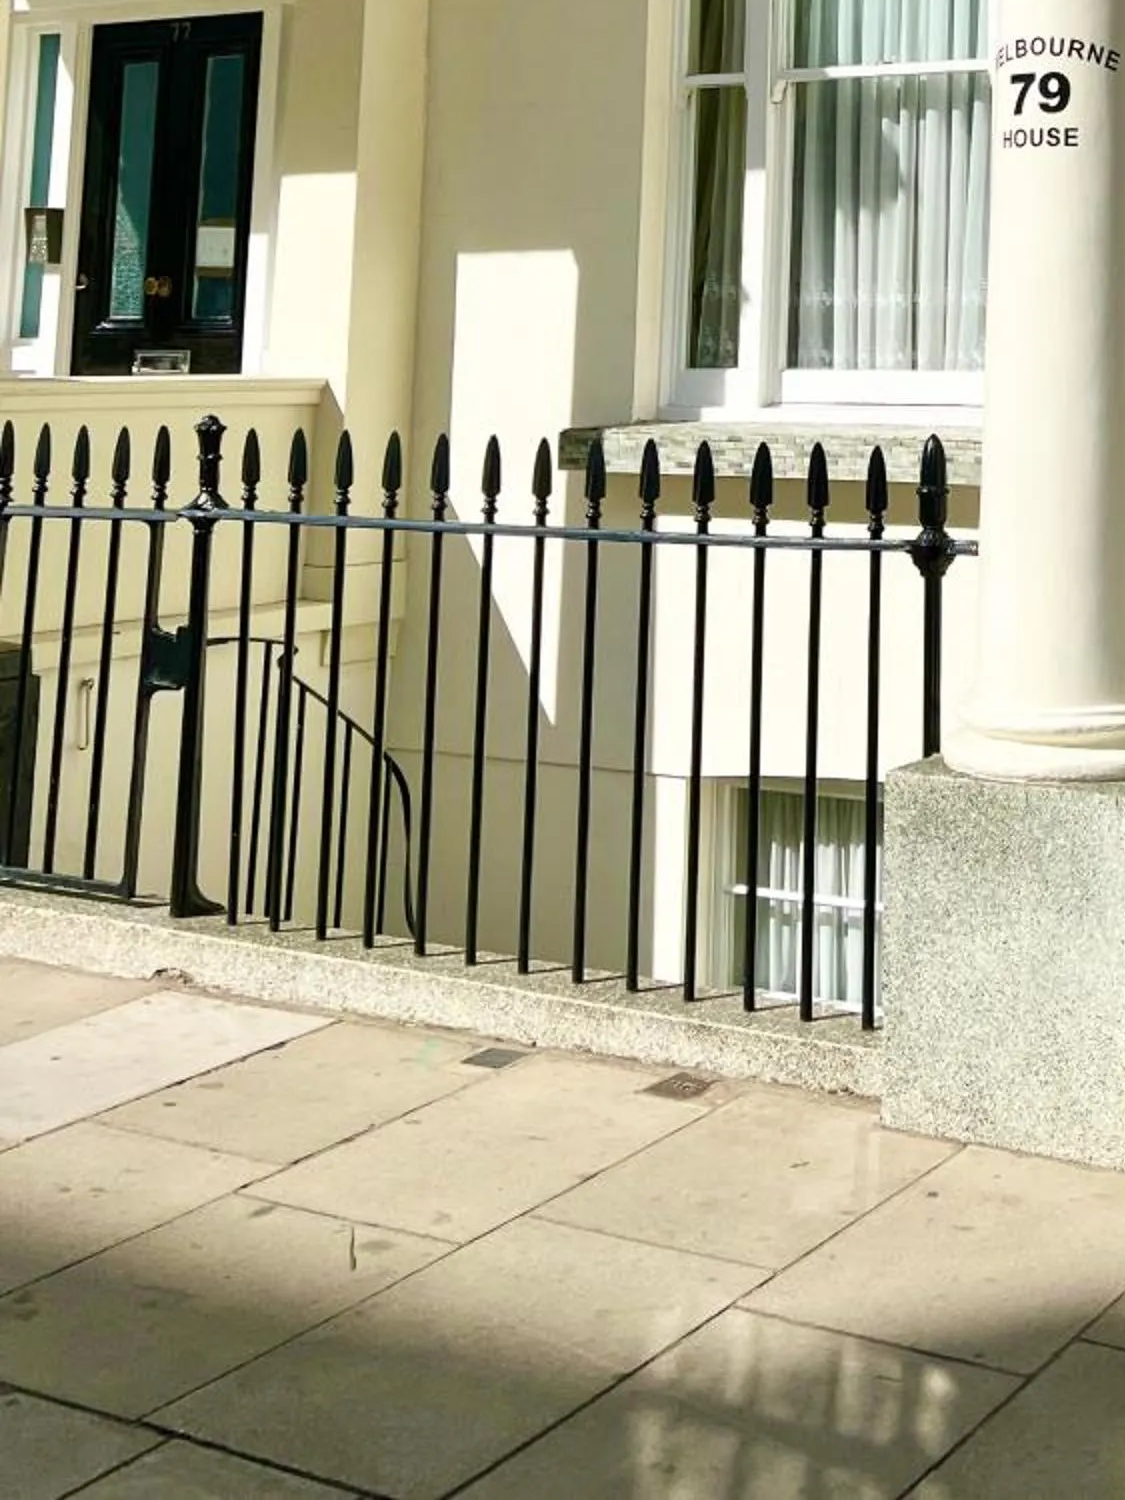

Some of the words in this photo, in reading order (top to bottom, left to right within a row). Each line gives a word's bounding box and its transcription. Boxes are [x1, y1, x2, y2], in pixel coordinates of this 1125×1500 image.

[995, 36, 1121, 71] ELBOURNE
[1010, 71, 1071, 116] 79
[1003, 127, 1079, 148] HOUSE
